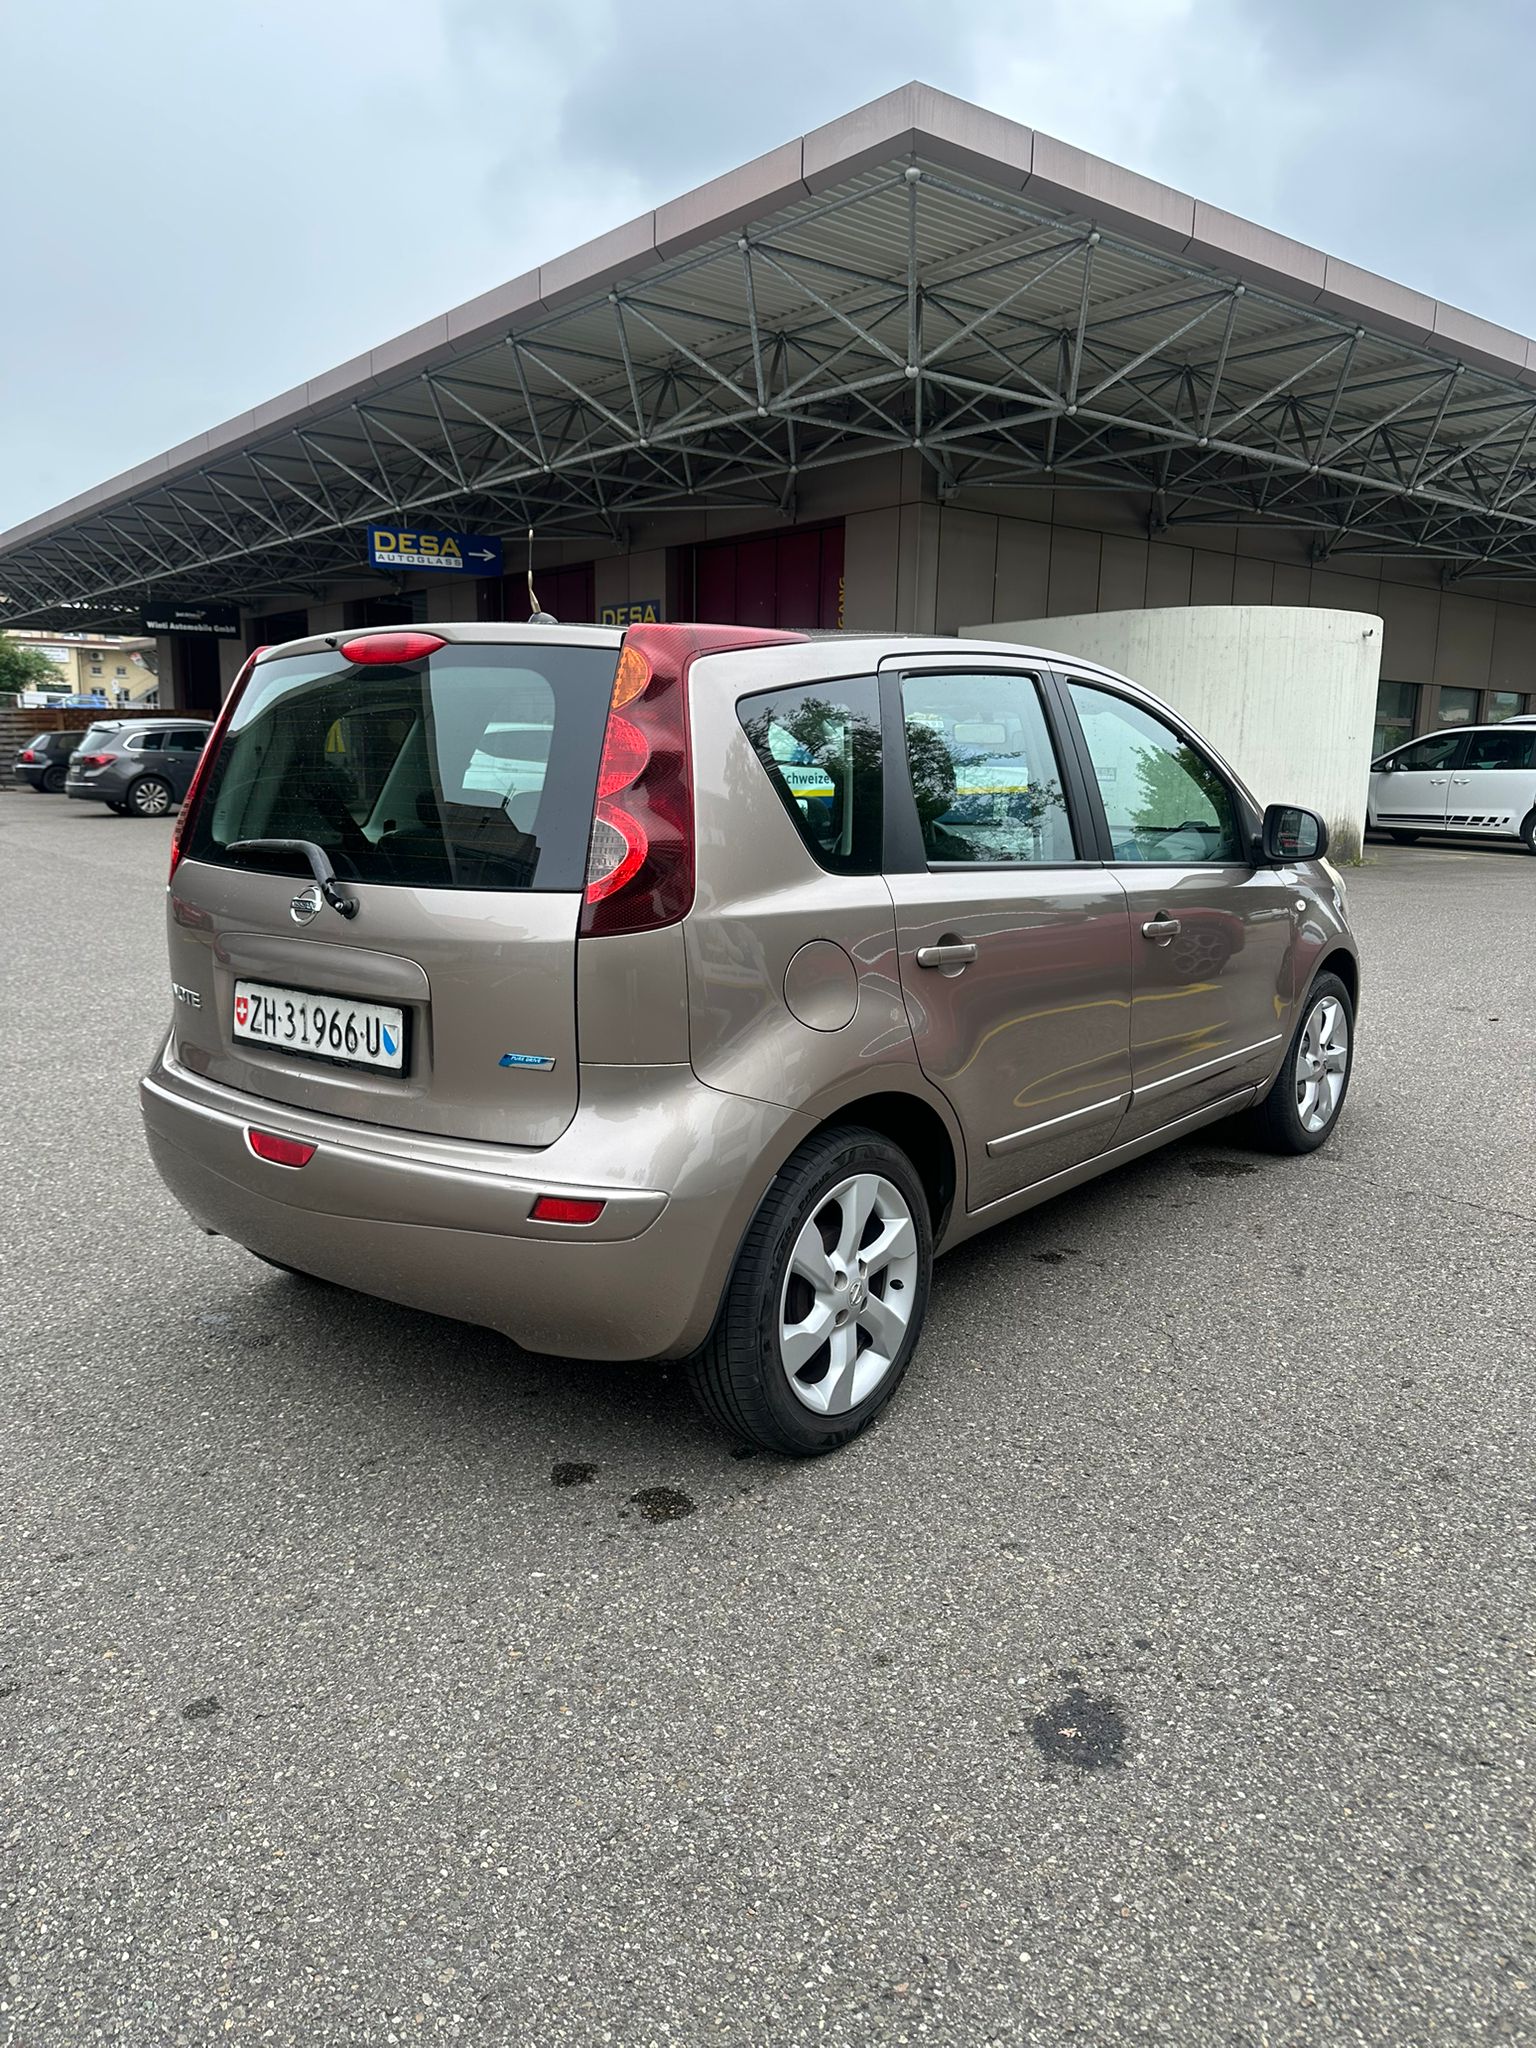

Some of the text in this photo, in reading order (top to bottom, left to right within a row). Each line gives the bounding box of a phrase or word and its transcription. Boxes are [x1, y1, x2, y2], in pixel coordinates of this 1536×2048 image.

[374, 531, 461, 557] DESA
[377, 554, 462, 567] AUTOGLASS
[602, 605, 656, 625] DESA
[169, 622, 213, 632] Automobile
[214, 625, 236, 633] GmbH
[784, 772, 834, 784] chweize
